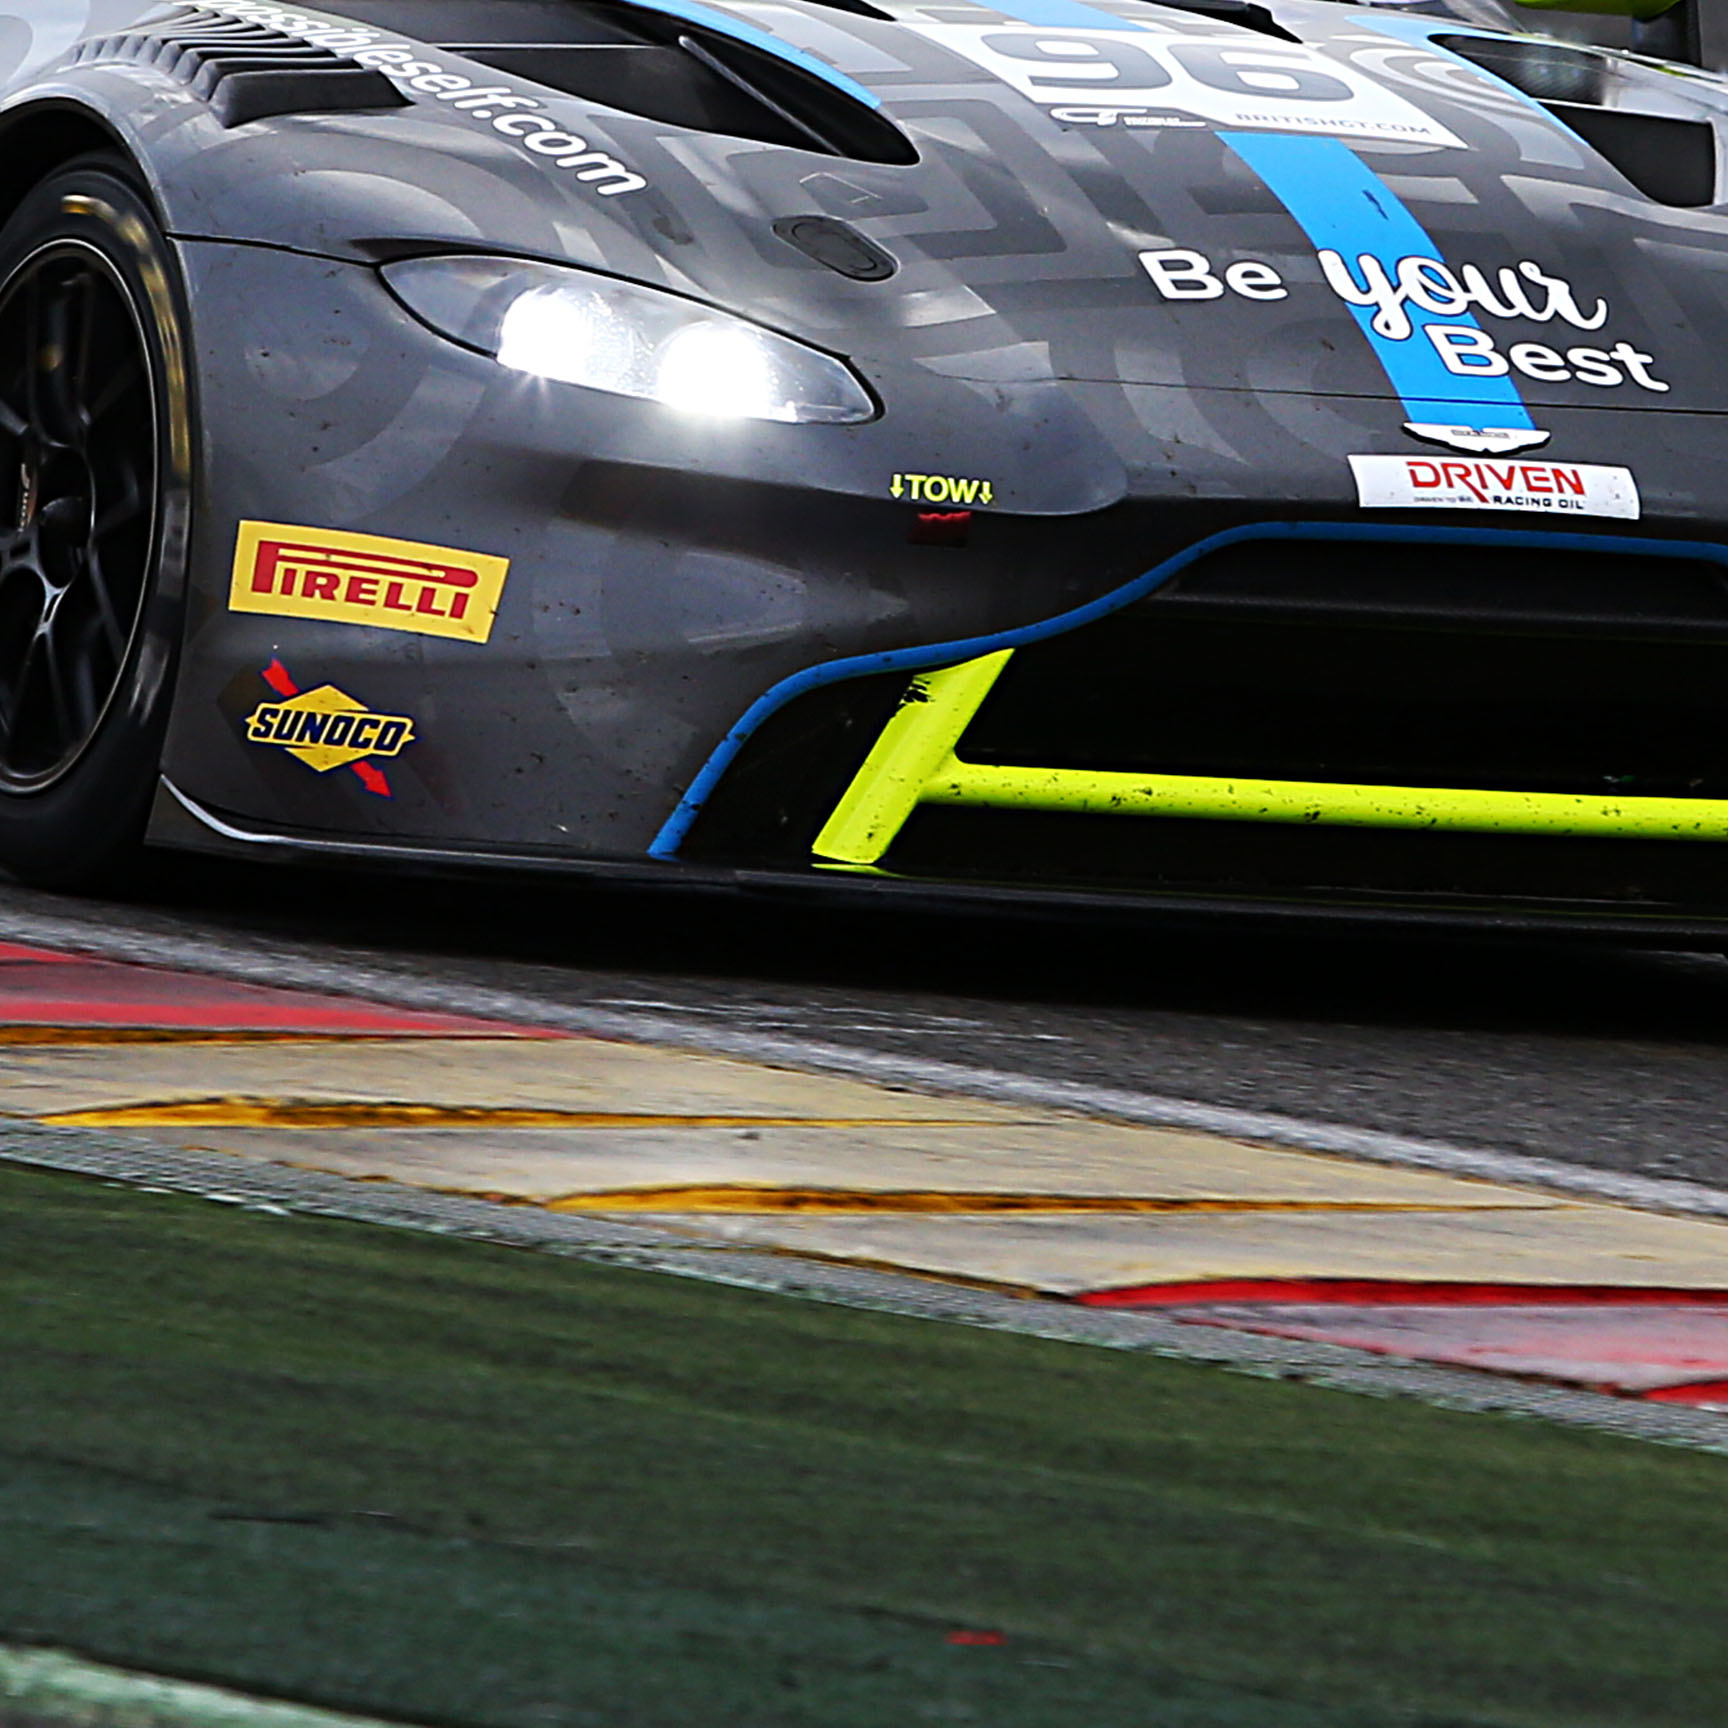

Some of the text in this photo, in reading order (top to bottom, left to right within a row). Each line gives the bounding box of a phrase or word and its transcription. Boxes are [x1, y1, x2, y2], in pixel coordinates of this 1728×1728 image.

[978, 32, 1356, 103] 96
[1234, 112, 1433, 136] BRITISHGT.COM
[1138, 247, 1609, 341] Be your
[1423, 325, 1671, 395] Best
[906, 474, 980, 505] TOW
[1405, 460, 1587, 504] DRIVEN
[1492, 495, 1585, 510] RACING OIL
[251, 539, 480, 620] PIRELLI
[249, 706, 411, 757] SUNOCO
